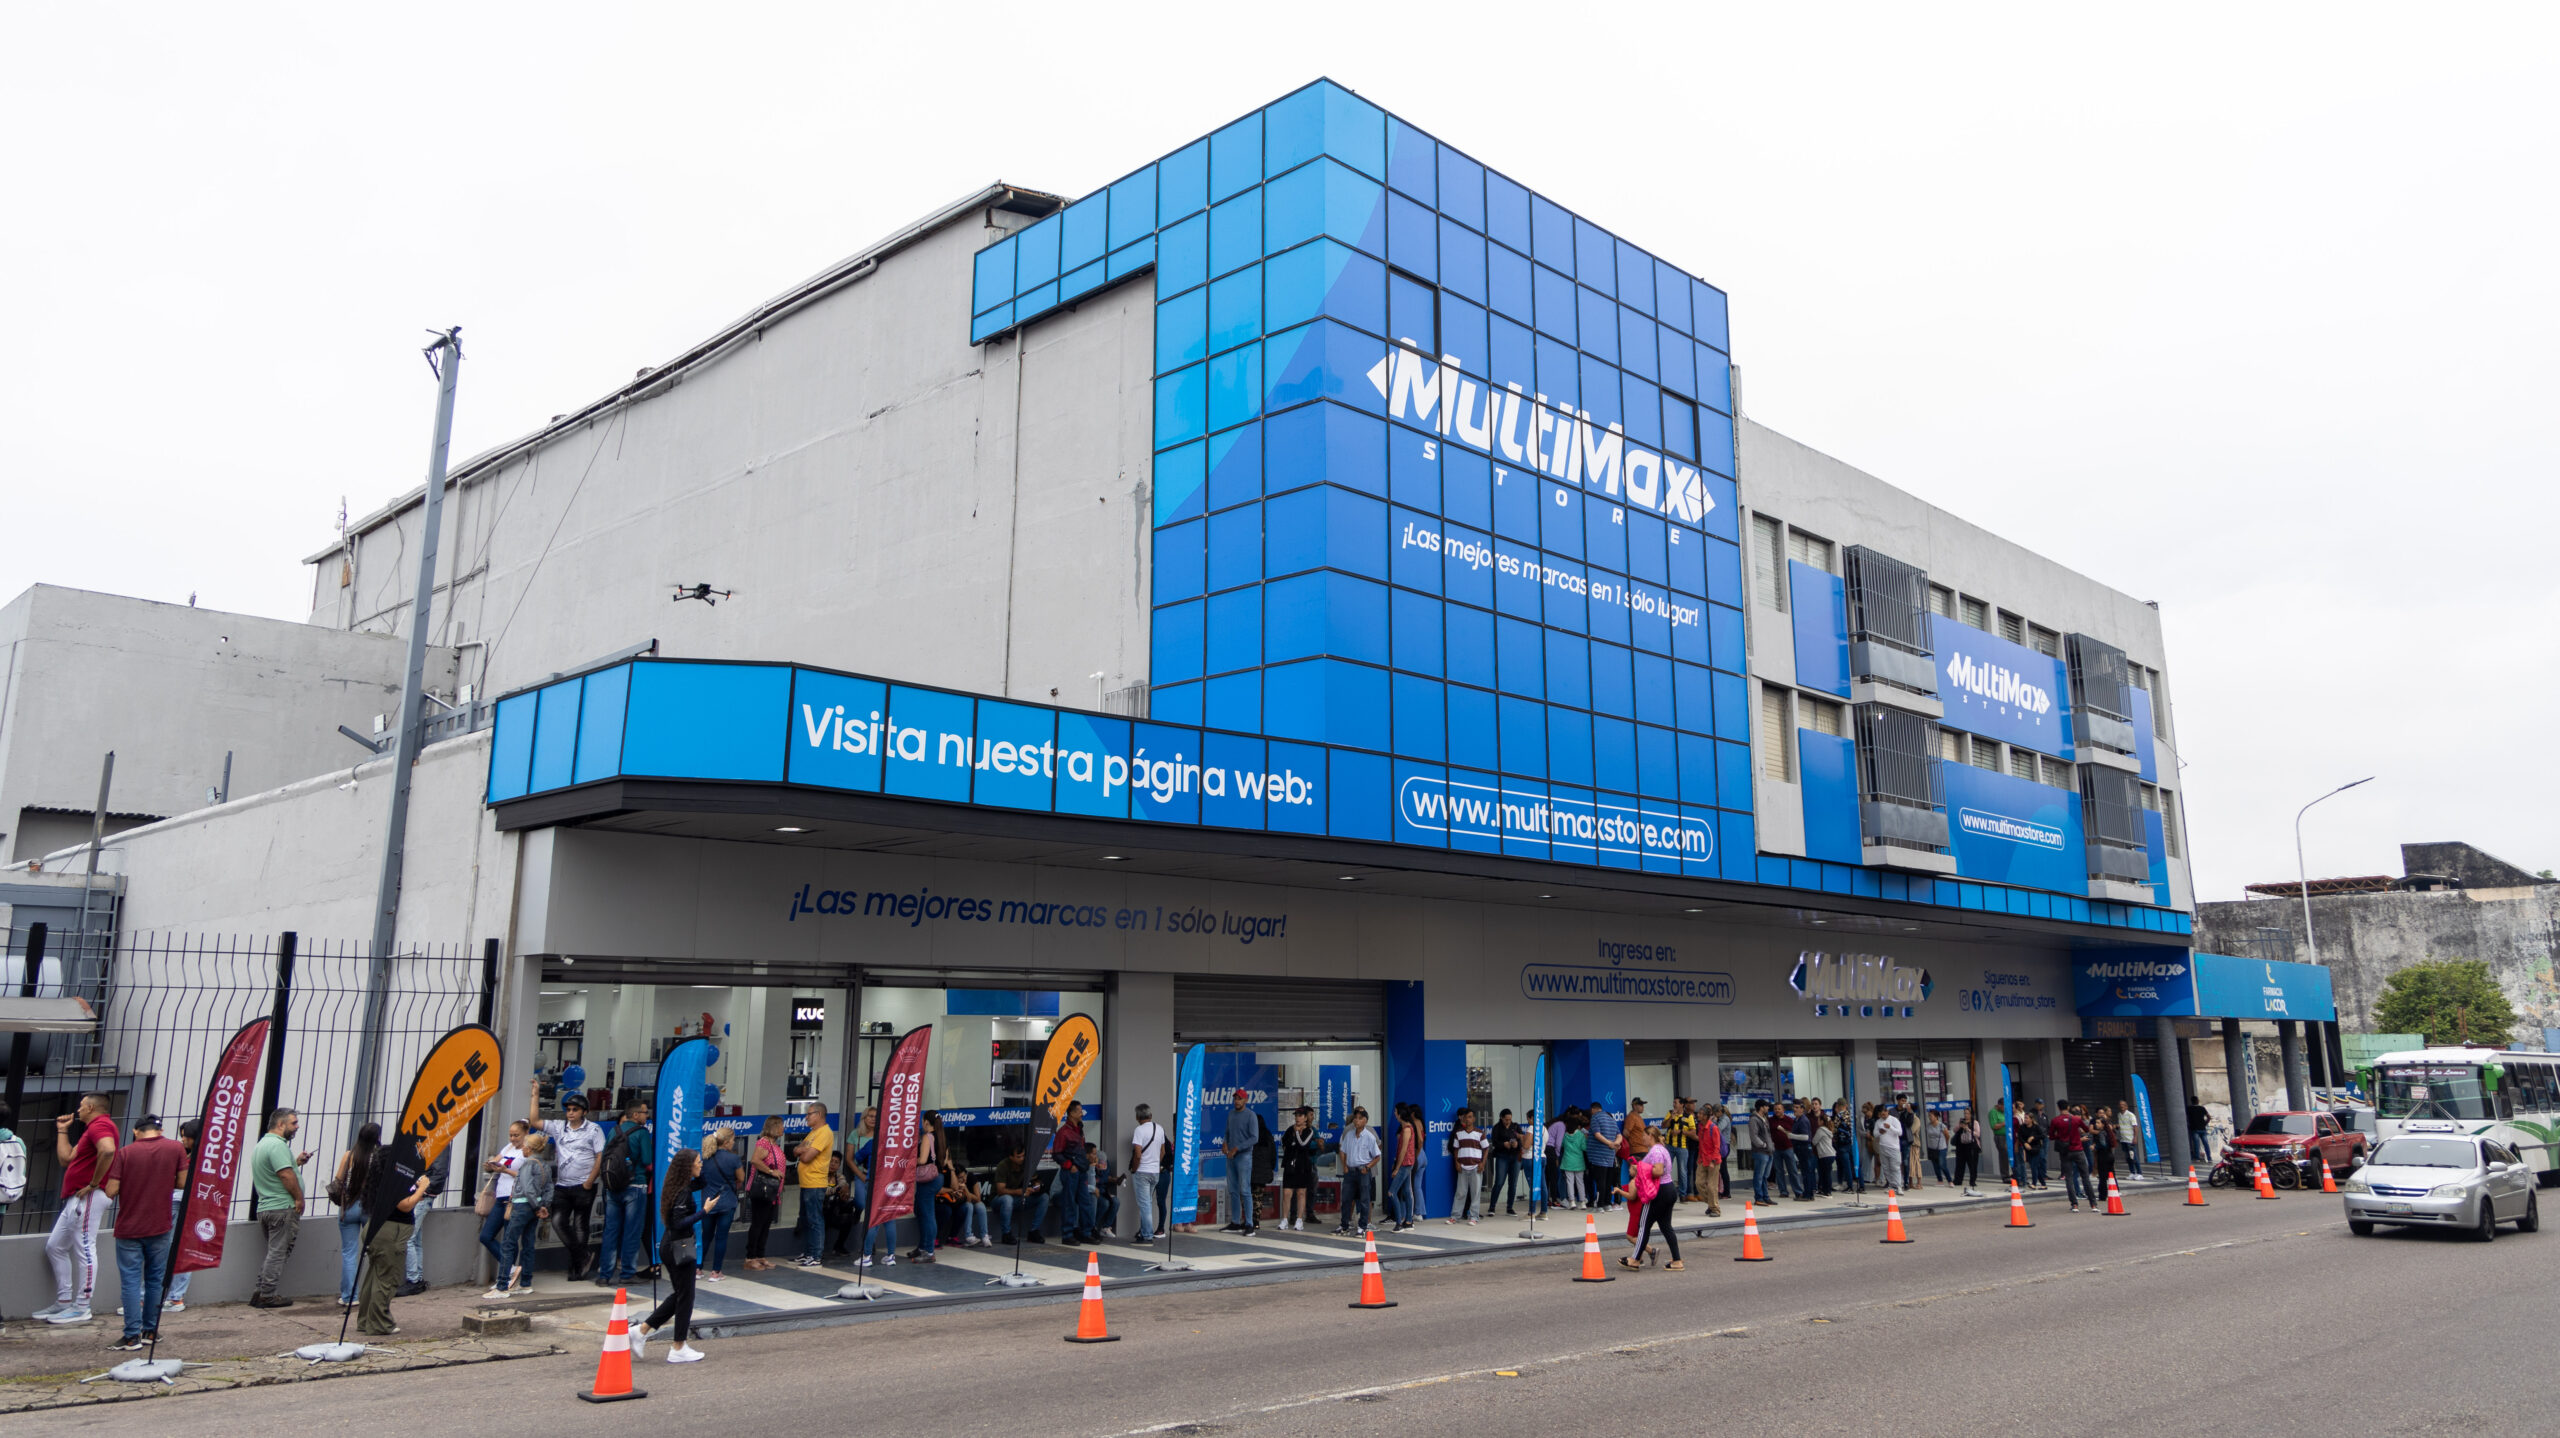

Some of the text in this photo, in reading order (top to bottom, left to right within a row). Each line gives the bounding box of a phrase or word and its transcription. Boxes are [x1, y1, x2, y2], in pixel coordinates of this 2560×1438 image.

[1389, 337, 1695, 522] MultiMax
[1422, 441, 1680, 545] STORE
[1402, 522, 1699, 627] ¡Las mejores marcas en 1 sólo lugar!
[1953, 652, 2044, 714] MultiMax
[1963, 695, 2041, 726] STORE
[802, 703, 1314, 807] Visita nuestra página web:
[1412, 789, 1707, 853] www.multimaxstore.com
[1962, 813, 2063, 847] www.multimaxstore.com
[789, 883, 1288, 945] ¡Las mejores marcas en 1 sólo lugar!
[1598, 938, 1677, 966] Ingresa en:
[1802, 951, 1925, 1002] MultiMax
[2091, 961, 2179, 978] MultiMax
[797, 1007, 825, 1021] KUC
[1528, 971, 1731, 999] www.multimaxstore.com
[1815, 1004, 1915, 1018] STORE
[1994, 993, 2056, 1010] @multimax_store
[2263, 986, 2284, 997] FARMACIA
[2096, 1021, 2137, 1038] FARMACIA
[405, 1050, 489, 1143] KUCCE
[1040, 1031, 1090, 1107] KUCCE
[2244, 1041, 2259, 1115] FARMACI
[201, 1075, 234, 1175] PROMOS
[220, 1079, 248, 1179] CONDESA
[667, 1096, 684, 1163] tiMax
[886, 1072, 906, 1148] PROMOS
[903, 1072, 921, 1149] CONDESA
[1181, 1091, 1195, 1168] MultiMax
[1428, 1120, 1453, 1133] Entra
